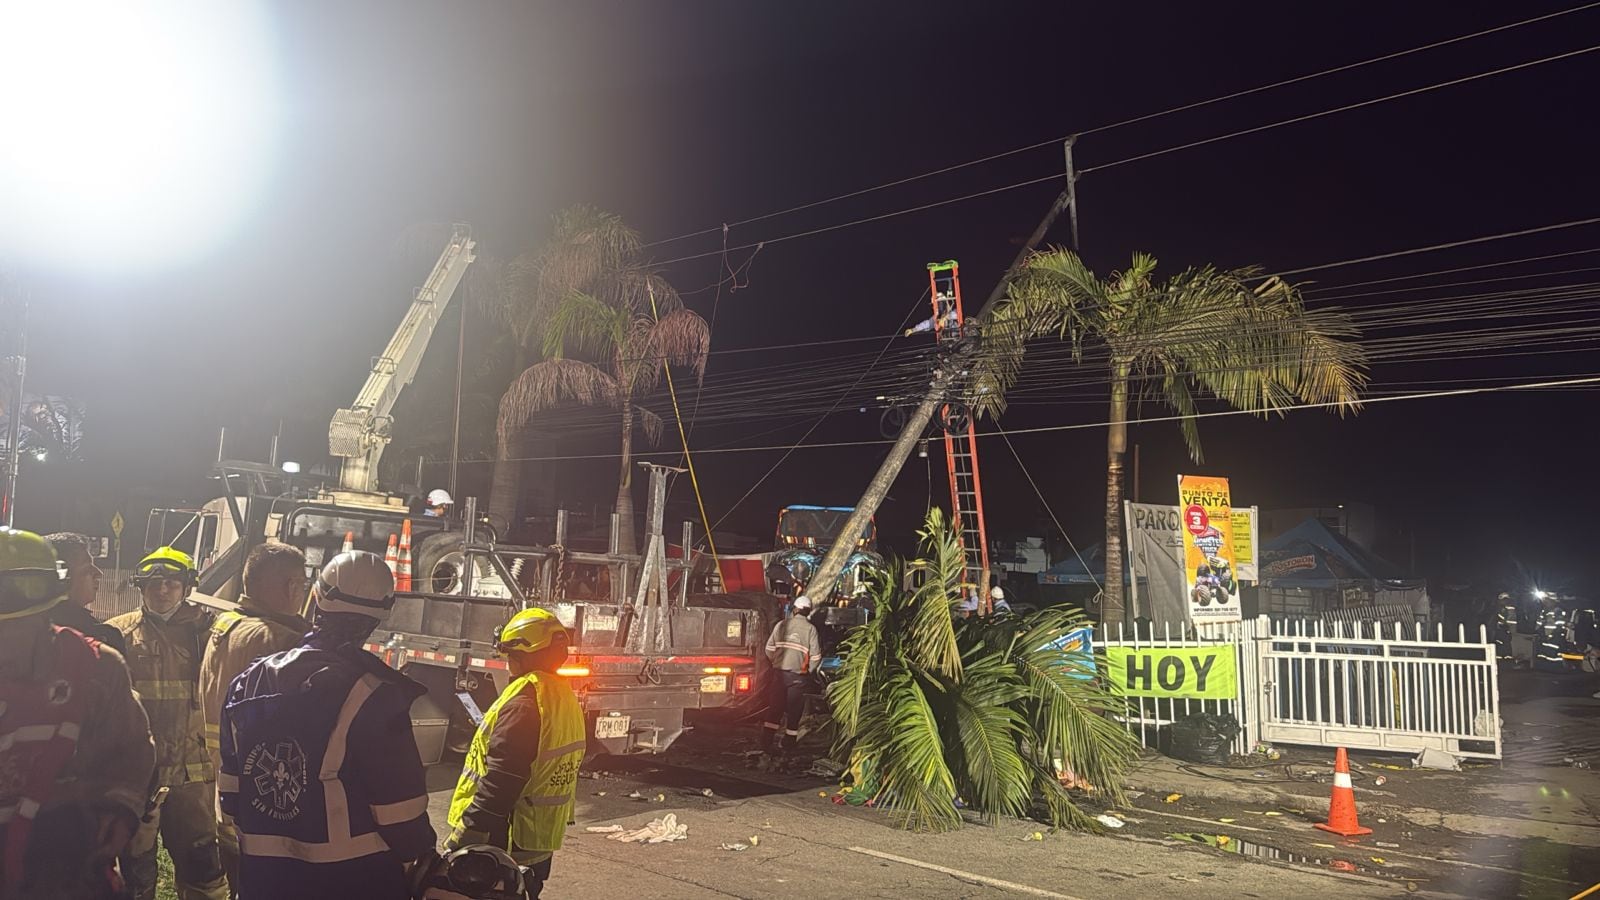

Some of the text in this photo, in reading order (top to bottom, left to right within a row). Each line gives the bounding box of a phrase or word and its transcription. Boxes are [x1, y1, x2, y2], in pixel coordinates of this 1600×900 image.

[1181, 489, 1213, 498] PUNTO
[1182, 495, 1230, 508] VENTA
[1134, 508, 1183, 532] PARQ
[1192, 516, 1202, 526] 3
[1126, 654, 1217, 692] HOY
